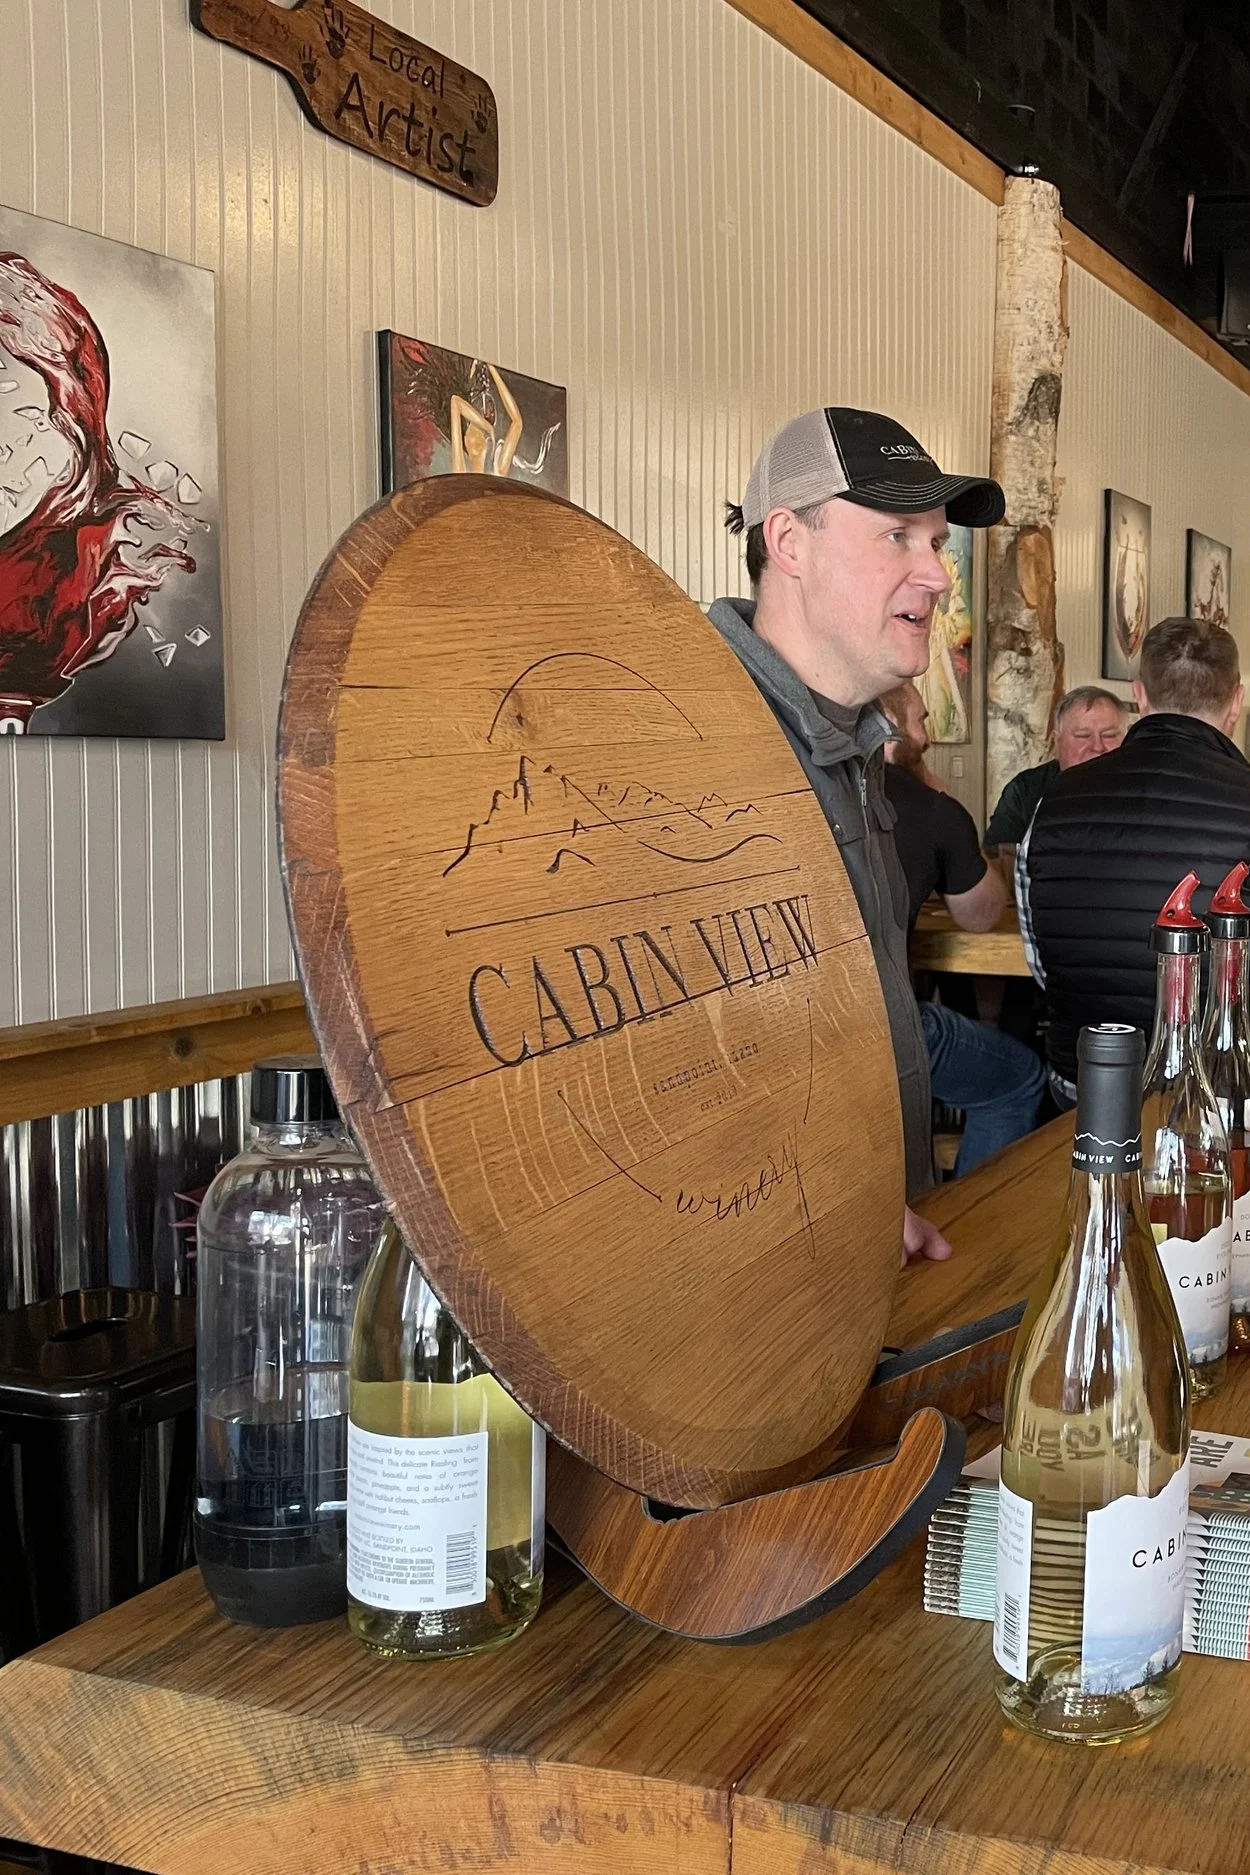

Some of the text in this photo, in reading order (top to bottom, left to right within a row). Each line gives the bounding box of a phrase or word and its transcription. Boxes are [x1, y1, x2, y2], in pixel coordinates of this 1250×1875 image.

[369, 24, 445, 98] Local
[334, 72, 476, 187] Artist
[468, 894, 820, 1069] CABIN VIEW
[676, 1115, 816, 1261] winery
[1089, 1154, 1114, 1164] VIEW
[1179, 1267, 1227, 1289] CABIN
[1190, 1435, 1234, 1468] ARE
